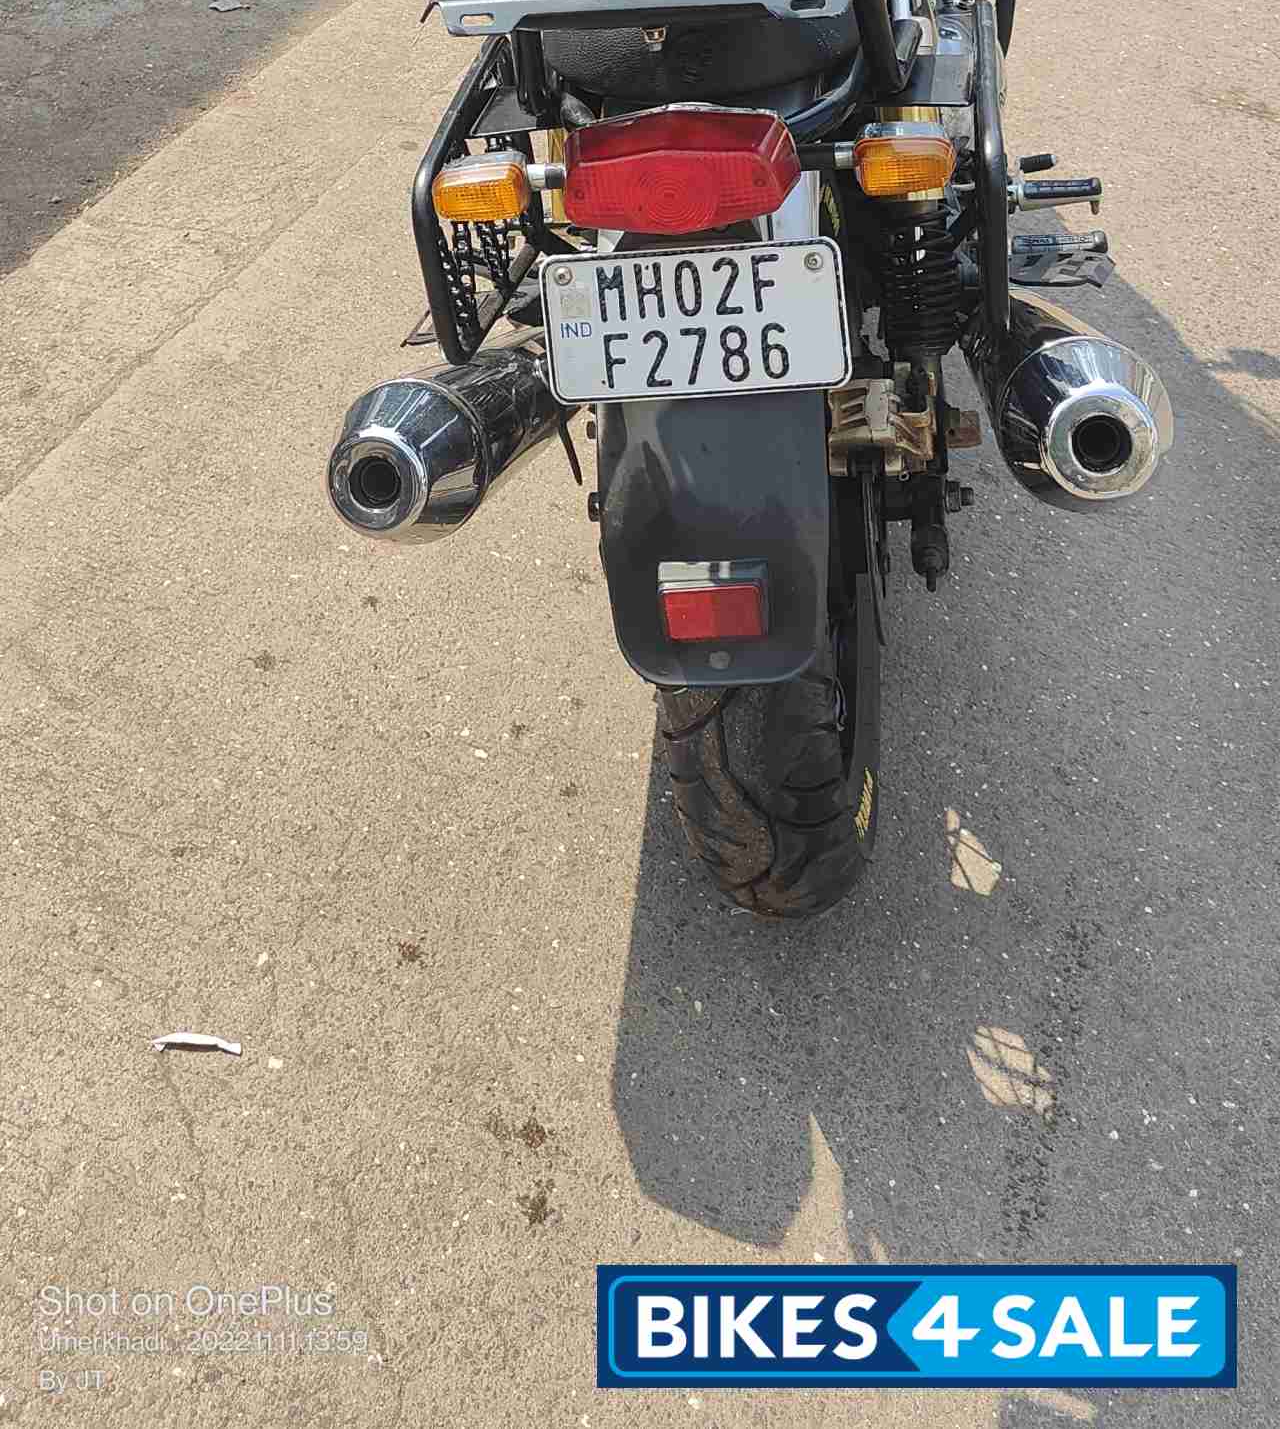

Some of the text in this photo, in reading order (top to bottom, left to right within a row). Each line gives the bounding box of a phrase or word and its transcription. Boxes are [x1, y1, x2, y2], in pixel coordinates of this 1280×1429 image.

[595, 253, 780, 322] MH02F
[560, 322, 593, 339] IND
[603, 322, 790, 389] F2786
